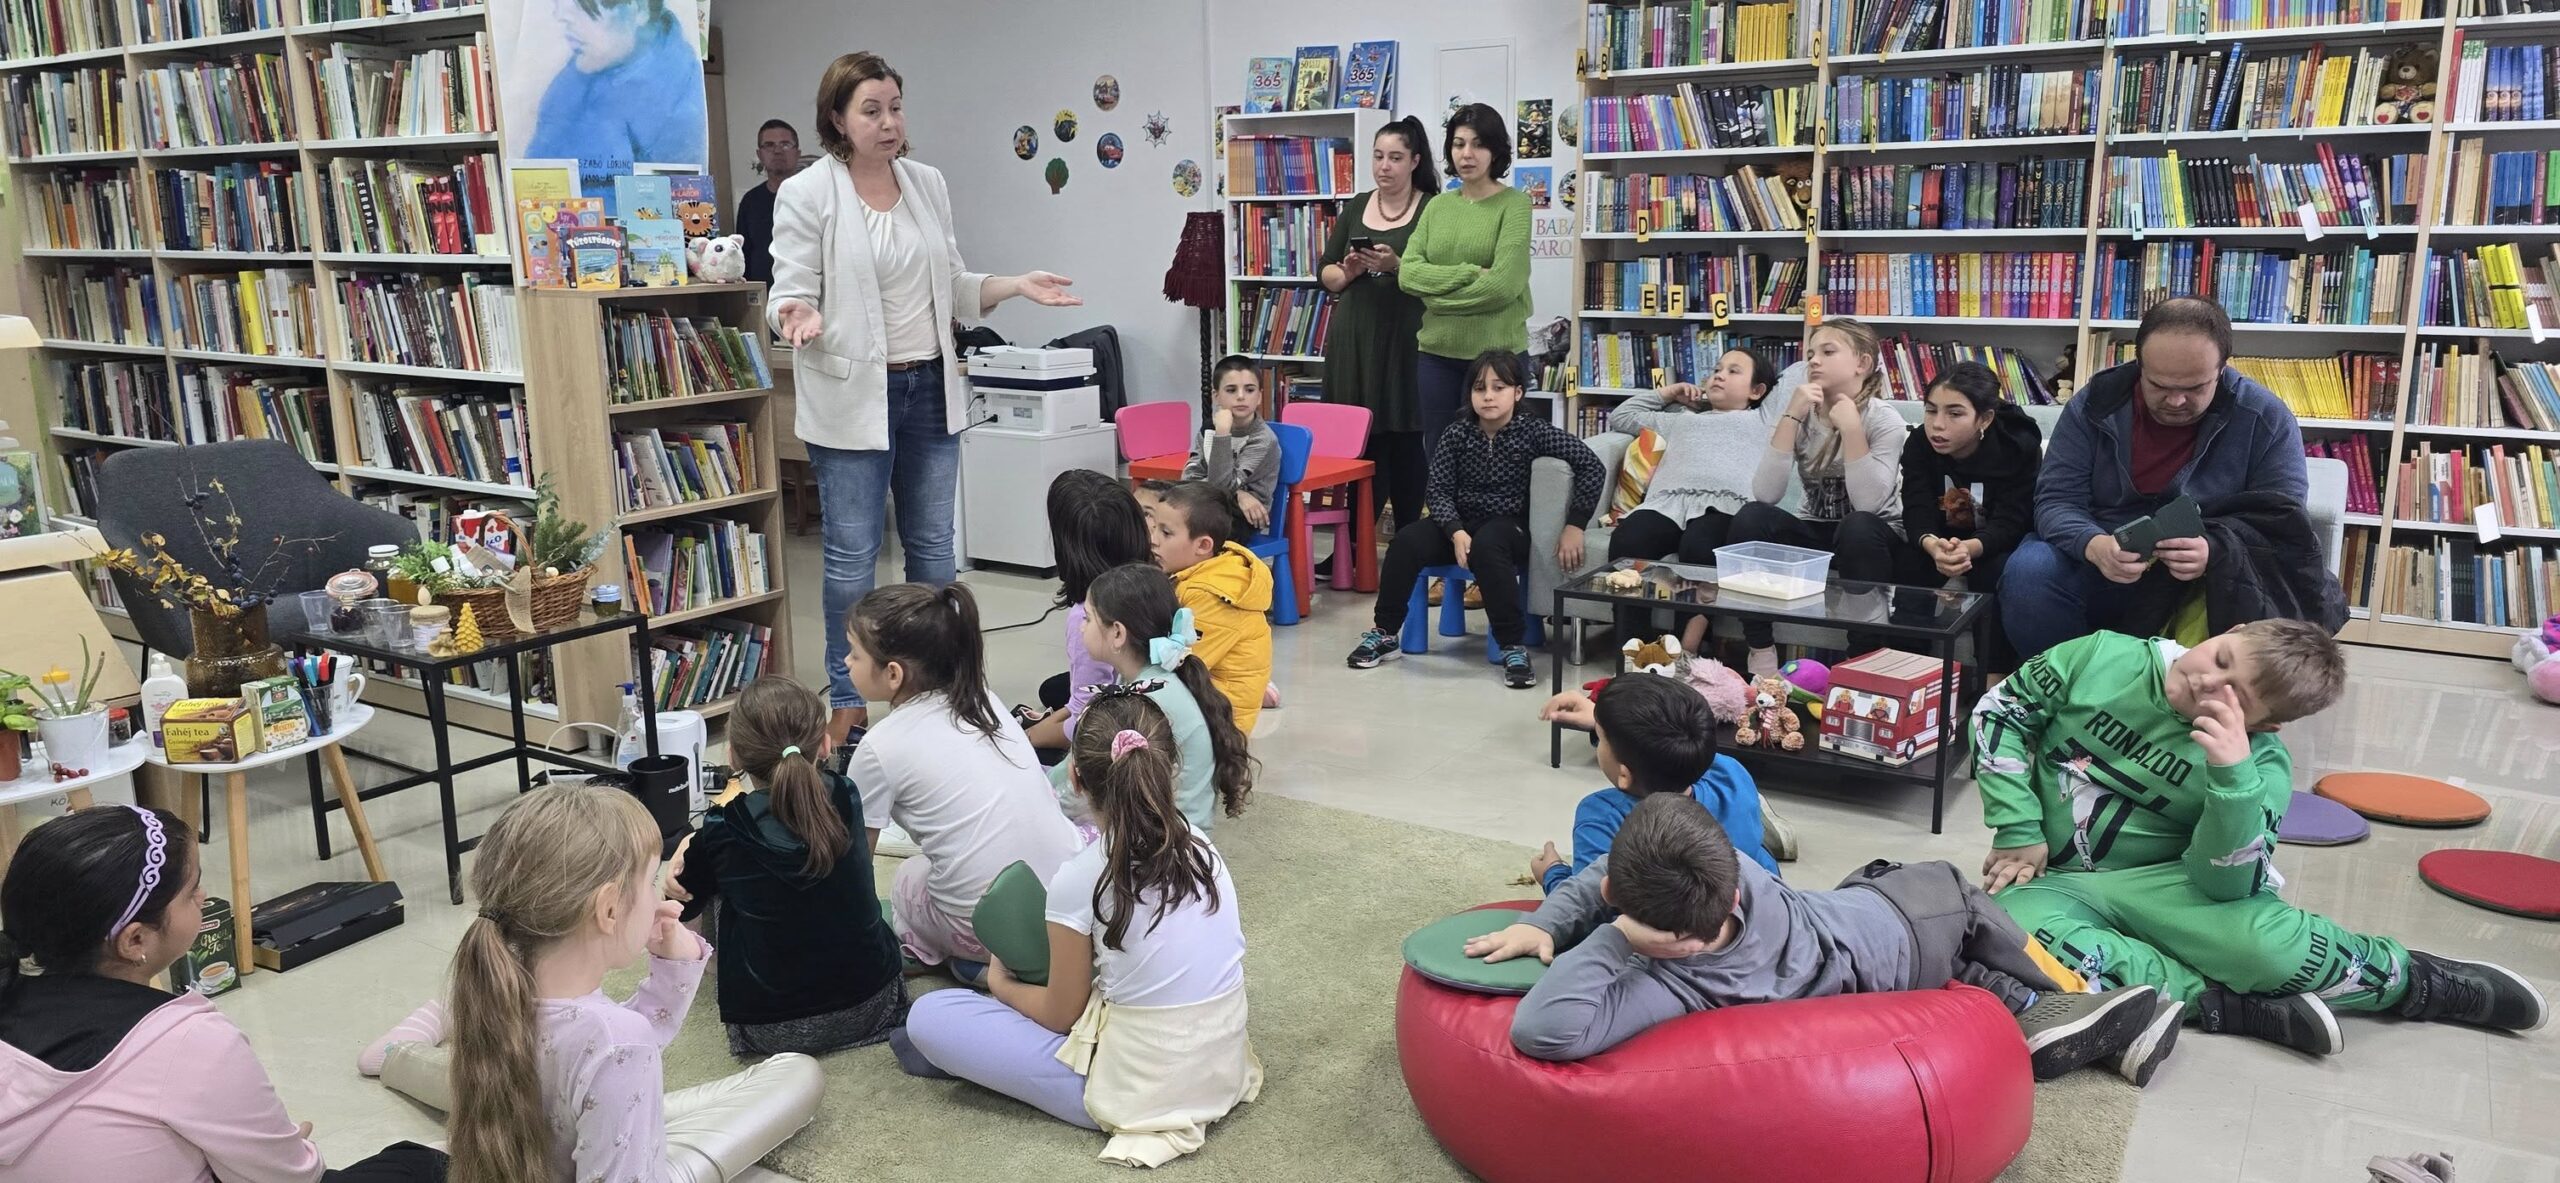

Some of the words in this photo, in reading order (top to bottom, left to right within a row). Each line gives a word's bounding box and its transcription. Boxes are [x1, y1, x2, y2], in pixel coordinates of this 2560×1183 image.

[2108, 18, 2115, 41] A
[2200, 12, 2206, 35] B
[1813, 38, 1820, 58] C
[1577, 55, 1586, 75] A
[1601, 53, 1608, 72] B
[1255, 75, 1282, 88] 365
[1350, 68, 1376, 82] 365
[357, 182, 376, 225] EUROPA
[1638, 216, 1648, 236] D
[1807, 216, 1815, 236] R
[2133, 210, 2142, 232] L
[1644, 290, 1654, 309] E
[1671, 291, 1681, 310] F
[1714, 300, 1728, 319] G
[1567, 372, 1576, 391] H
[1654, 374, 1663, 389] K
[165, 727, 192, 738] Fahéj
[194, 728, 210, 736] tea
[2083, 710, 2193, 788] RONALDO
